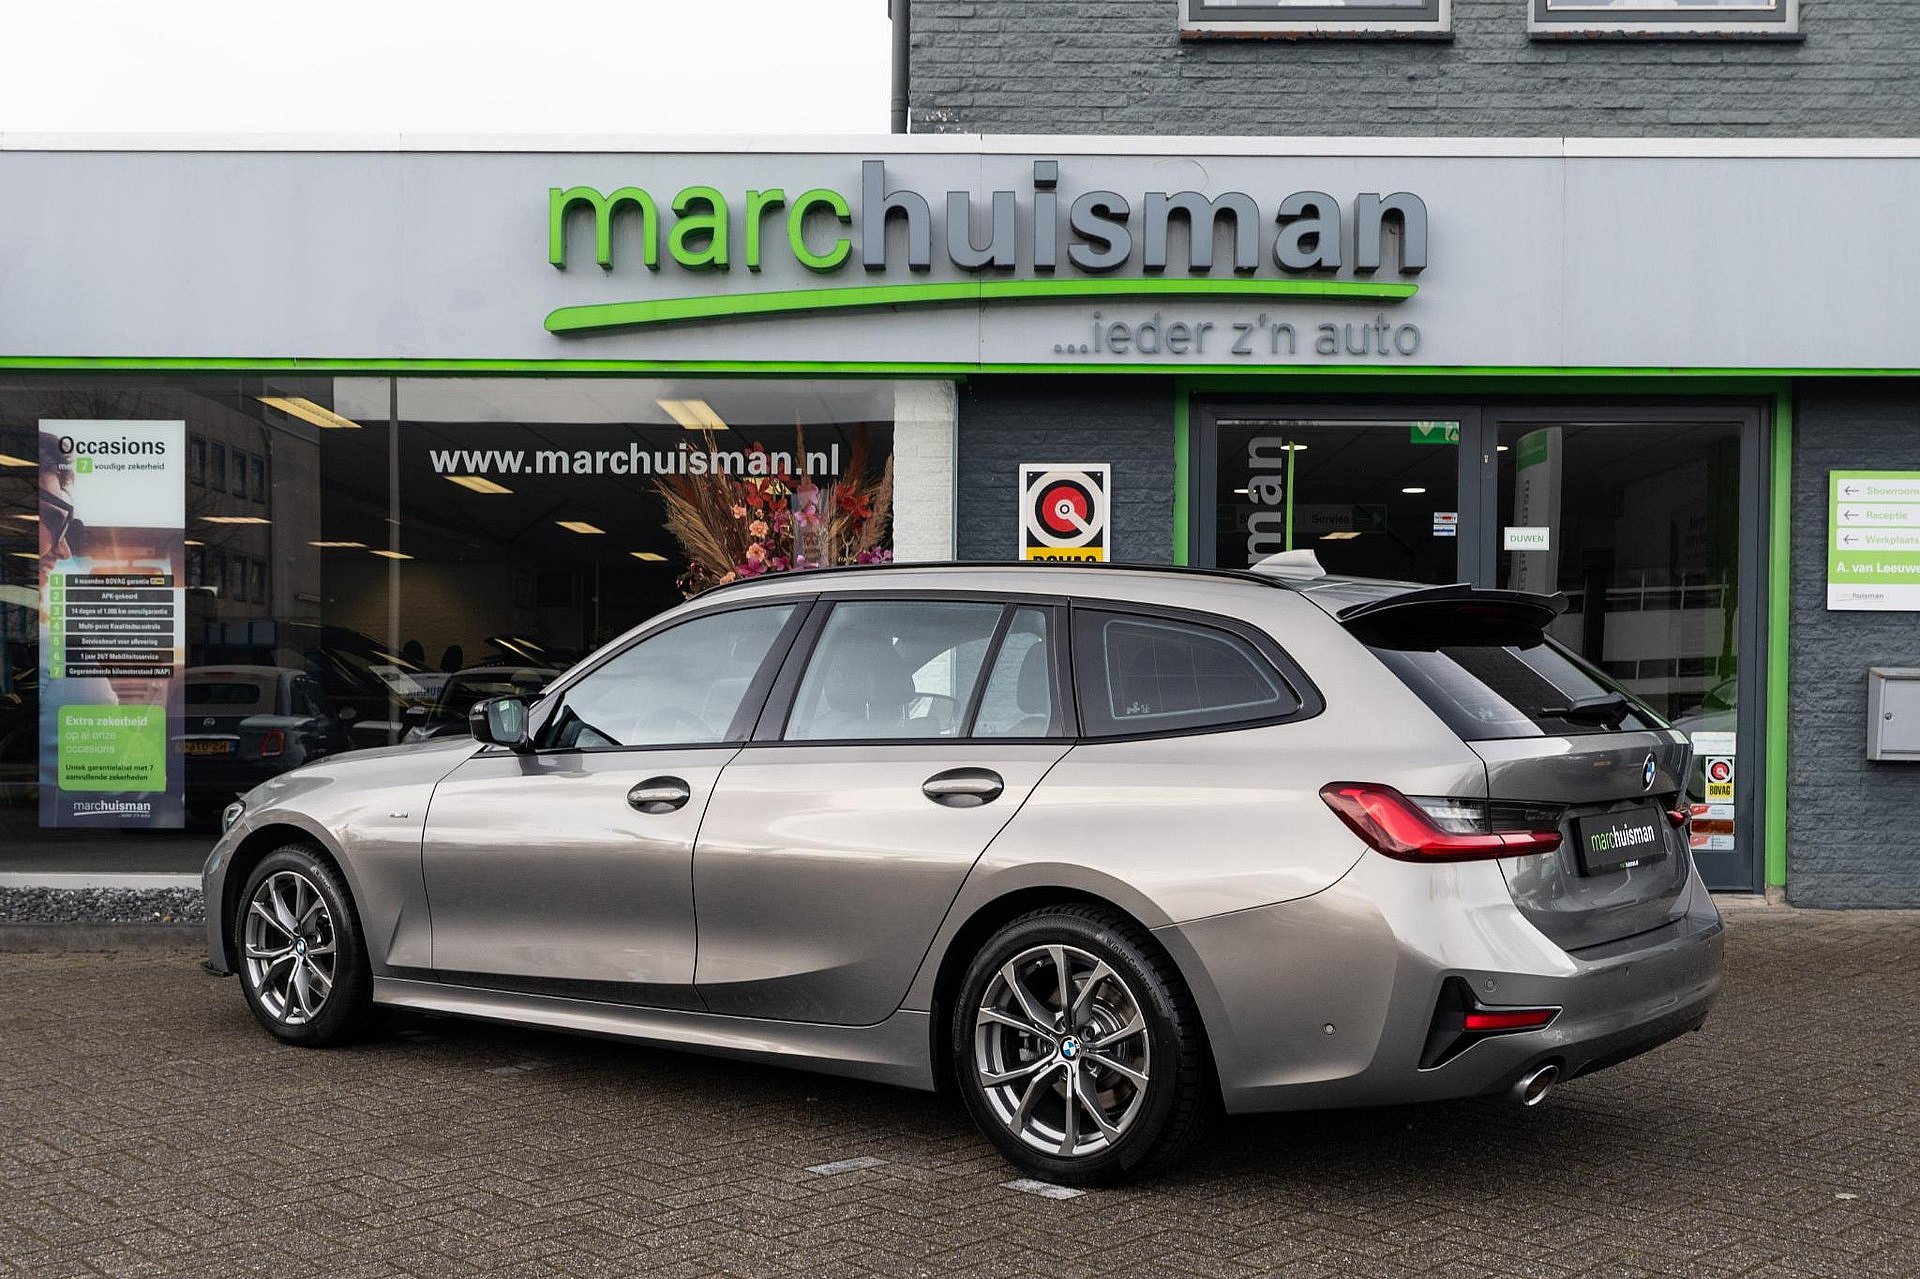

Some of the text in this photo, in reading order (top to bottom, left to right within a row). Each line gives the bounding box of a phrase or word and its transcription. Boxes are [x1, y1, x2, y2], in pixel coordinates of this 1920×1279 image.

[549, 160, 1428, 275] marchuisman
[1231, 313, 1295, 354] z'n
[1315, 312, 1421, 355] auto
[59, 435, 166, 455] Occasions
[430, 442, 839, 475] www.marchuisman.nl
[95, 463, 125, 472] voudige
[128, 462, 165, 470] zekerheid
[1866, 486, 1920, 496] Showroom
[1866, 511, 1908, 521] Receptie
[1865, 534, 1920, 545] Werkplaats
[1852, 564, 1873, 573] van
[66, 715, 149, 727] Extra zekerheid
[92, 731, 117, 740] onze
[65, 744, 116, 753] occasions
[1709, 785, 1731, 796] BOVAG
[73, 800, 151, 811] marchuisman
[1590, 823, 1656, 852] marchuisman
